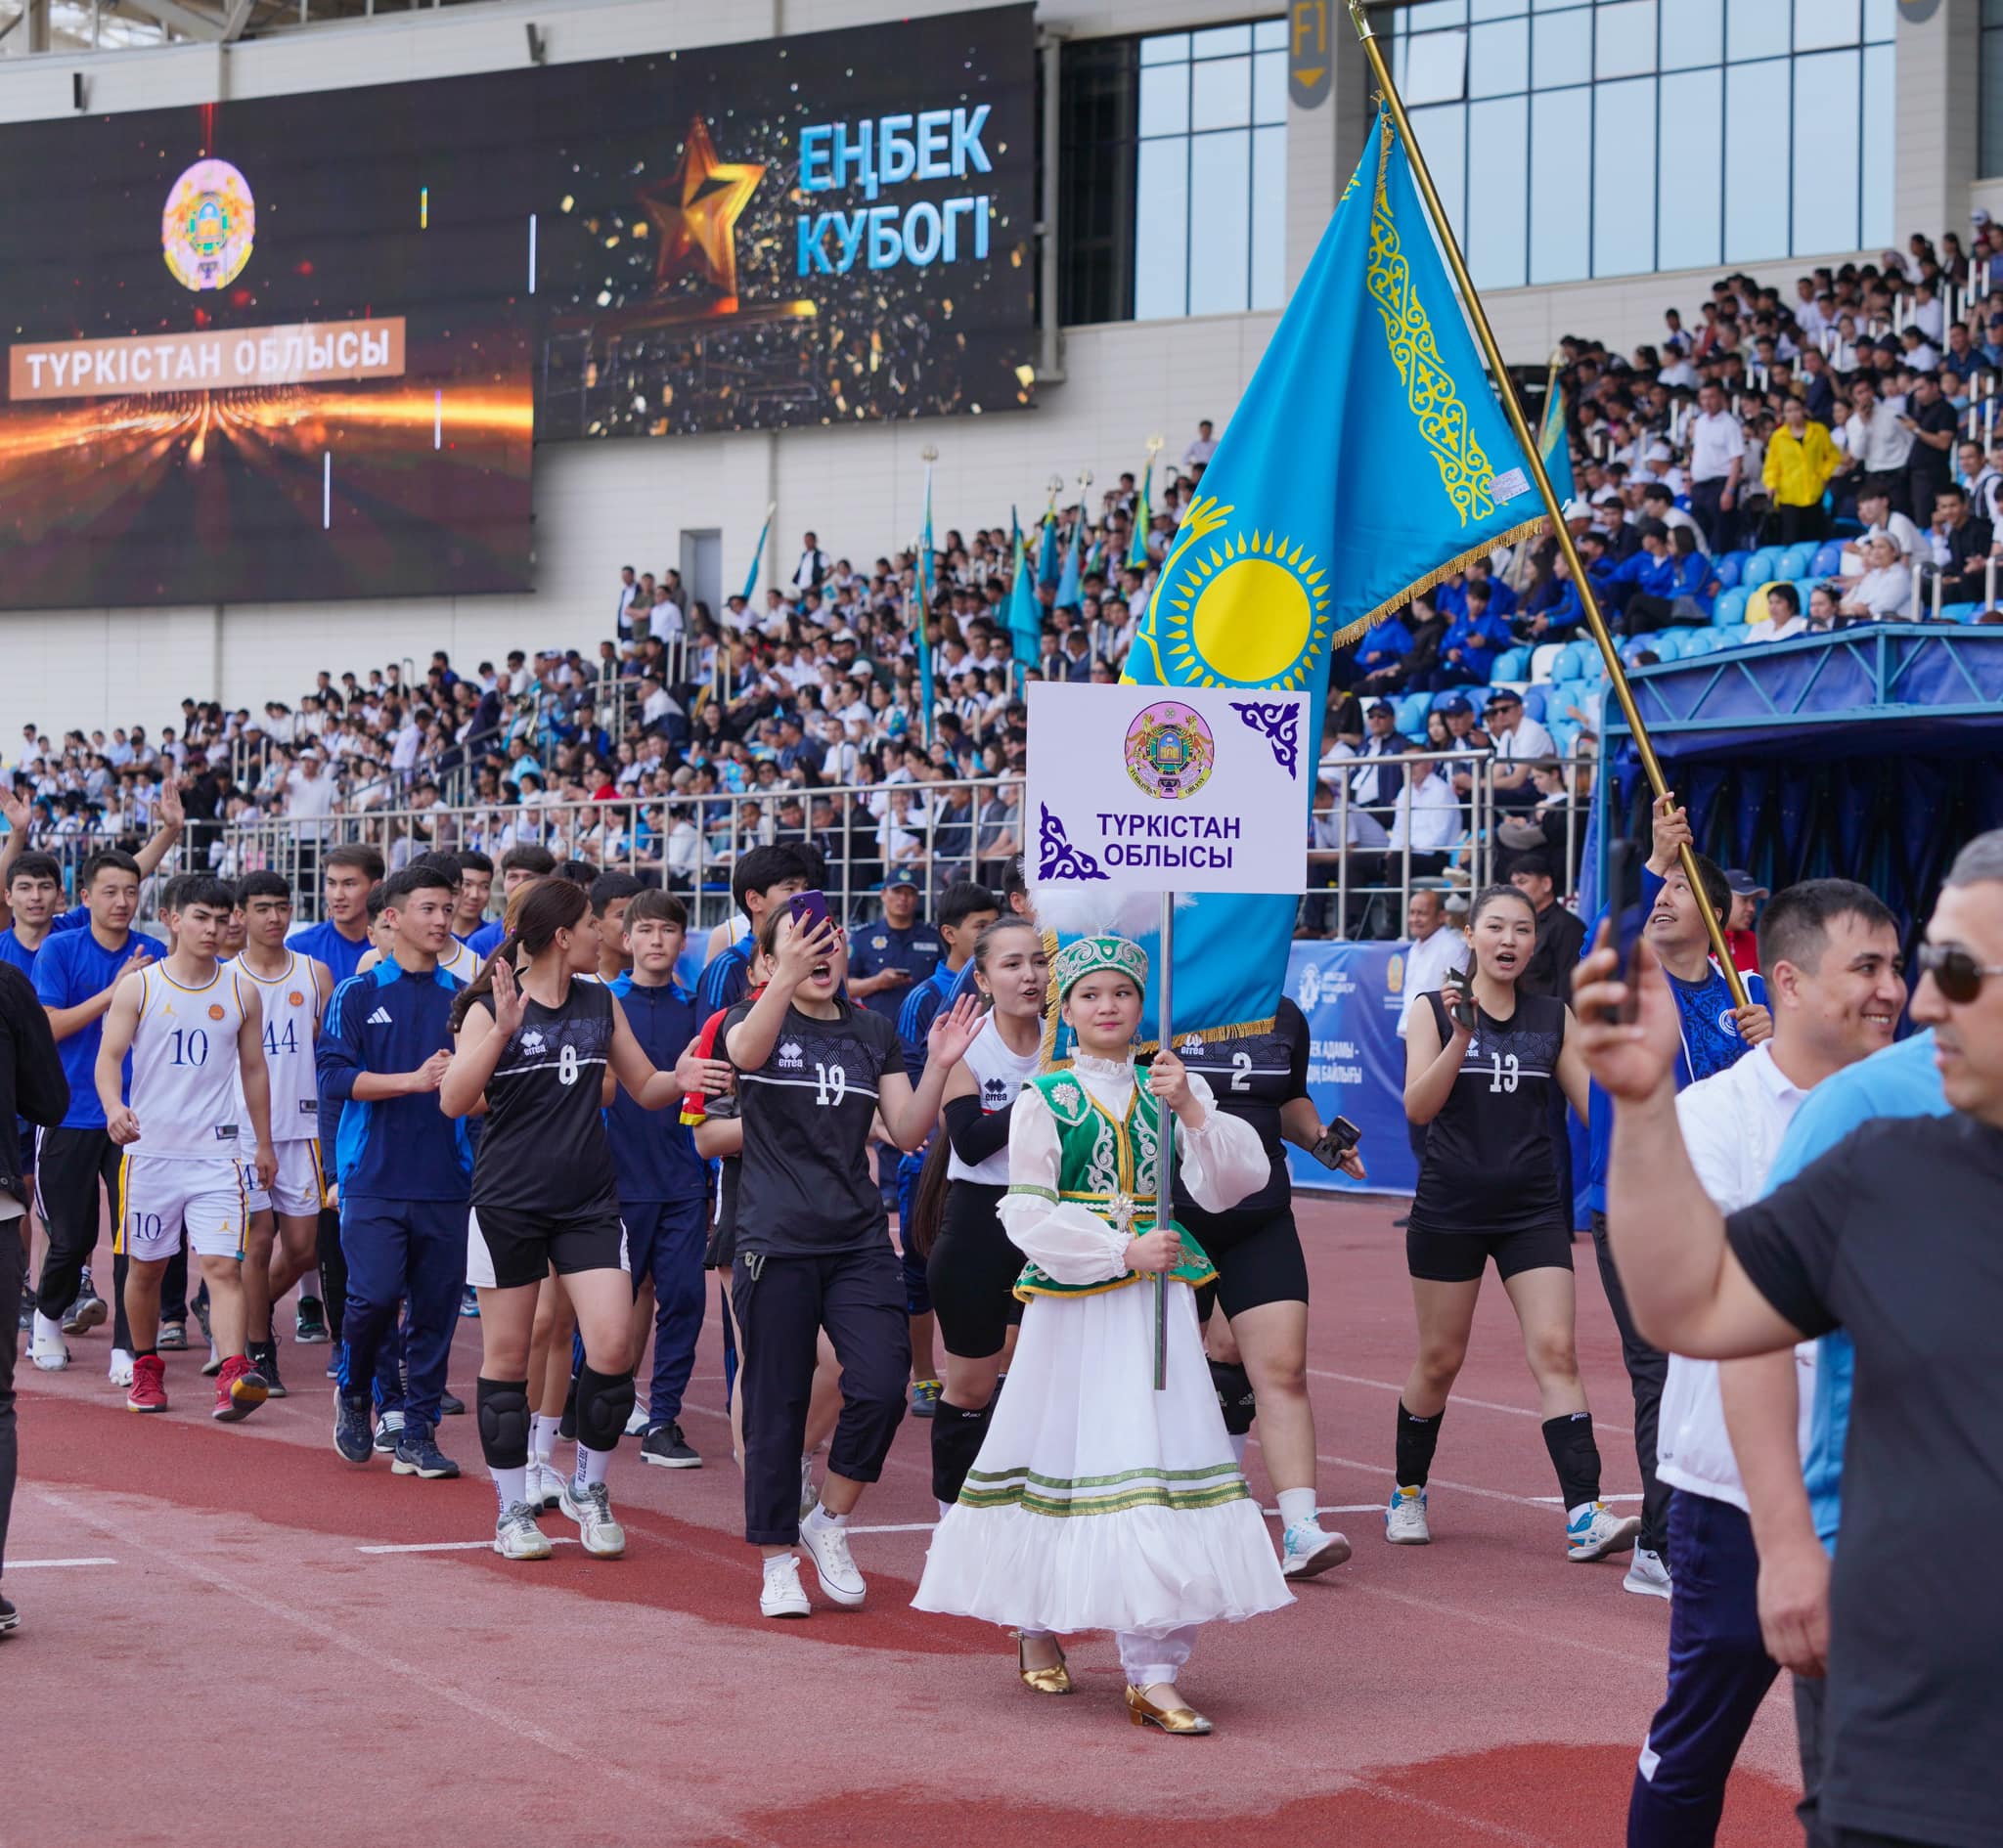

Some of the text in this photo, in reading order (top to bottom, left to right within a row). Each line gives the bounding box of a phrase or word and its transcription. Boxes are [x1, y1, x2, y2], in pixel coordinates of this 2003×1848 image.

[799, 104, 993, 201] ЕҢБЕК
[797, 195, 990, 277] КУБОГІ
[25, 329, 390, 388] ТҮРКІСТАН ОБЛЫСЫ
[1096, 813, 1241, 839] ТҮРКІСТАН
[1103, 843, 1233, 869] ОБЛЫСЫ
[169, 1028, 209, 1067] 10
[262, 1018, 299, 1056] 44
[558, 1043, 579, 1086] 8
[815, 1062, 846, 1107] 19
[1230, 1051, 1253, 1091] 2
[1489, 1051, 1519, 1093] 13
[132, 1210, 162, 1241] 10
